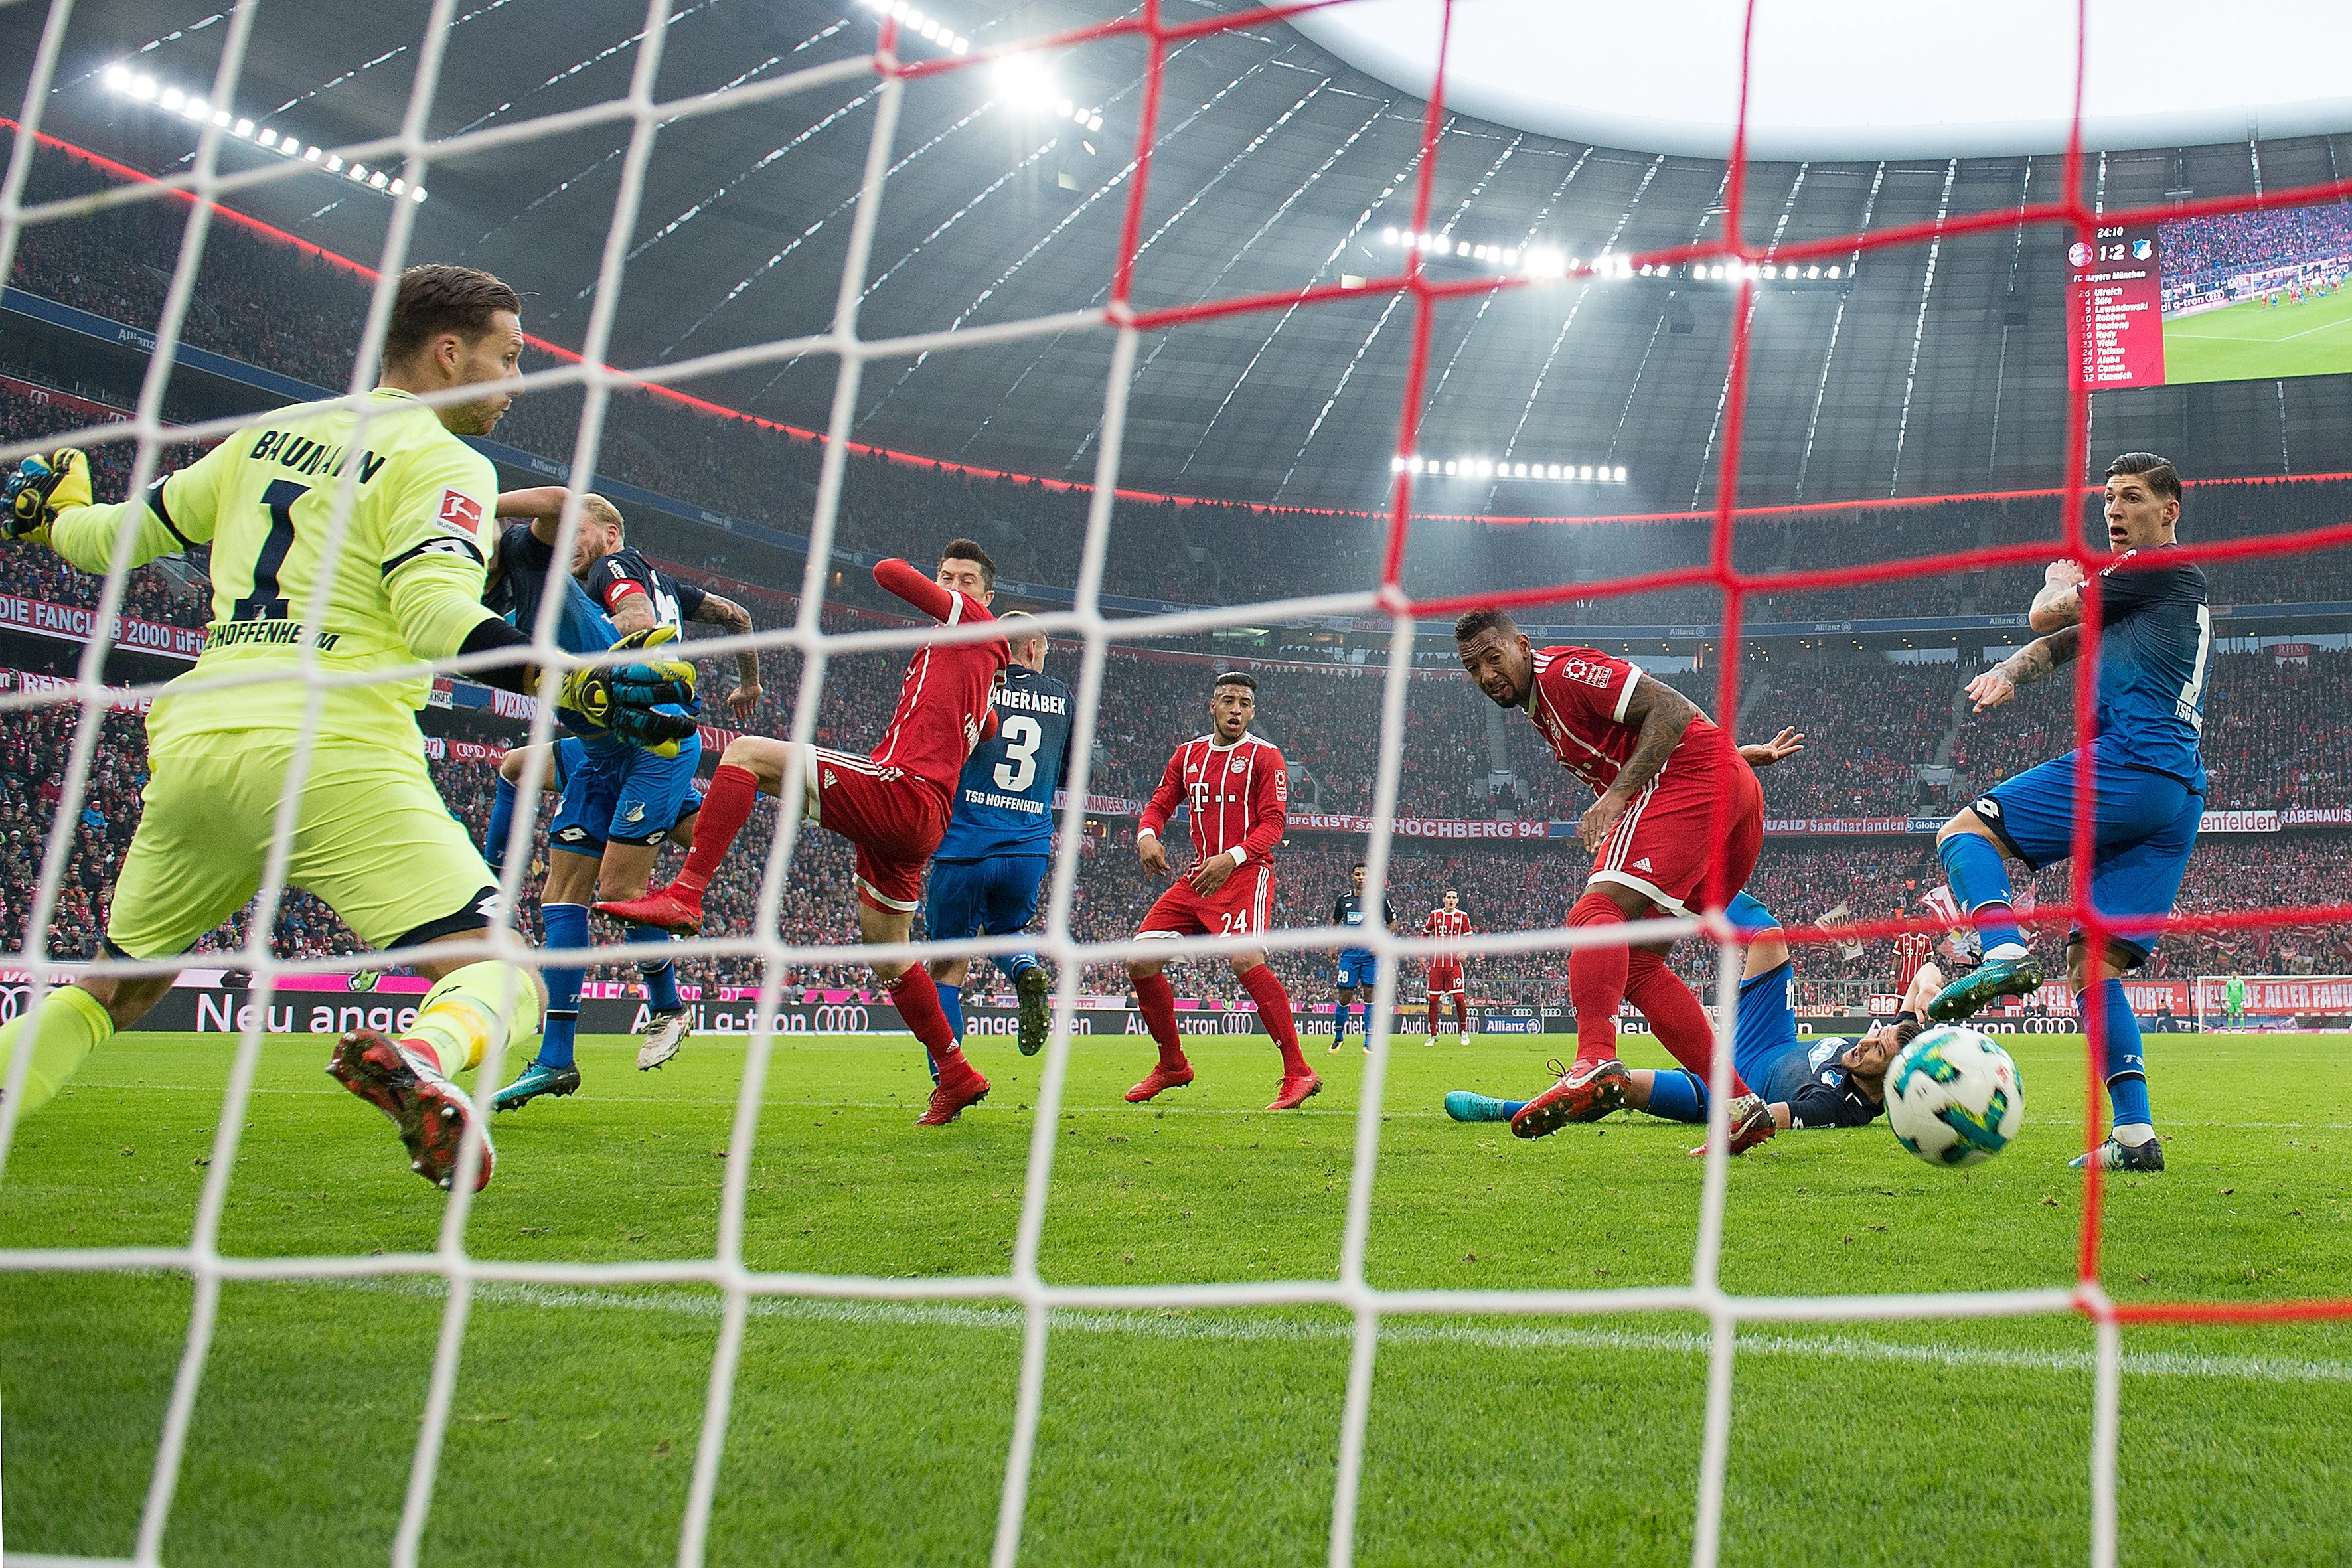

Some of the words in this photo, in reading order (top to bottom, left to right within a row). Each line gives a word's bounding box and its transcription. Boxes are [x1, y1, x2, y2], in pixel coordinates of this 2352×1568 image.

[2096, 226, 2124, 238] 24:10
[2100, 244, 2126, 261] 1:2
[2073, 274, 2083, 283] FC
[2085, 273, 2111, 283] Bayern
[118, 329, 157, 350] Allianz
[231, 479, 312, 622] 1
[35, 603, 123, 641] FANCLB
[127, 622, 171, 649] 2000
[1814, 623, 1841, 631] Allianz
[1989, 617, 2015, 625] Allianz
[214, 621, 340, 651] HOFFENHEM
[1668, 627, 1695, 636] Allianz
[2278, 643, 2304, 655] RHM
[993, 688, 1066, 716] ADEŘÁBEK
[2175, 700, 2192, 722] TSG
[992, 714, 1042, 793] 3
[965, 789, 985, 805] TSG
[1289, 817, 1309, 825] BFC
[1809, 819, 1906, 833] Sandharlanden
[1915, 821, 1943, 830] Global
[1219, 909, 1248, 939] 24
[1337, 969, 1349, 984] 29
[1452, 978, 1462, 988] 19
[2264, 984, 2310, 1008] ALLER
[715, 1007, 807, 1032] g-ton
[1400, 1016, 1425, 1034] Audi
[1486, 1019, 1525, 1033] Allianz
